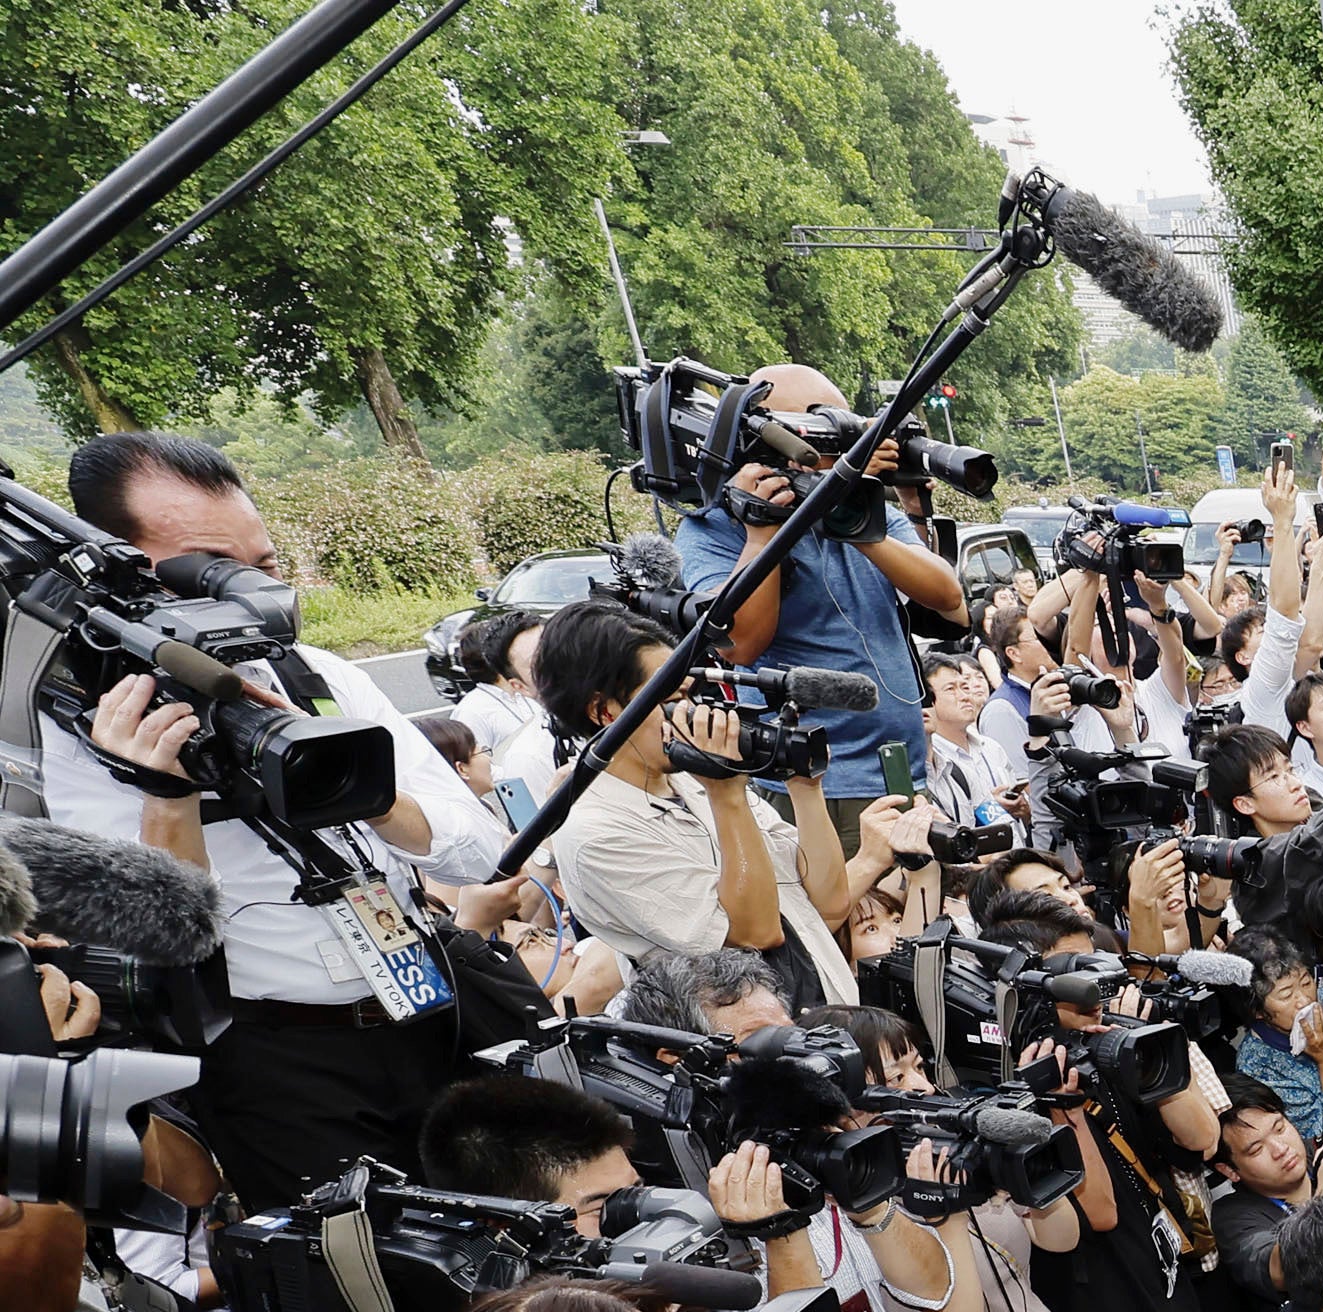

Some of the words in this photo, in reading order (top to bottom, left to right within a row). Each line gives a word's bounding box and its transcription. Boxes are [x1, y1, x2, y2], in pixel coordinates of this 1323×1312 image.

[684, 443, 700, 458] TB
[206, 631, 231, 640] SONY
[336, 906, 372, 954] レビ東京
[370, 960, 388, 979] TV
[384, 982, 412, 1019] TOKY
[386, 946, 437, 1006] ESS
[913, 1191, 945, 1203] SONY
